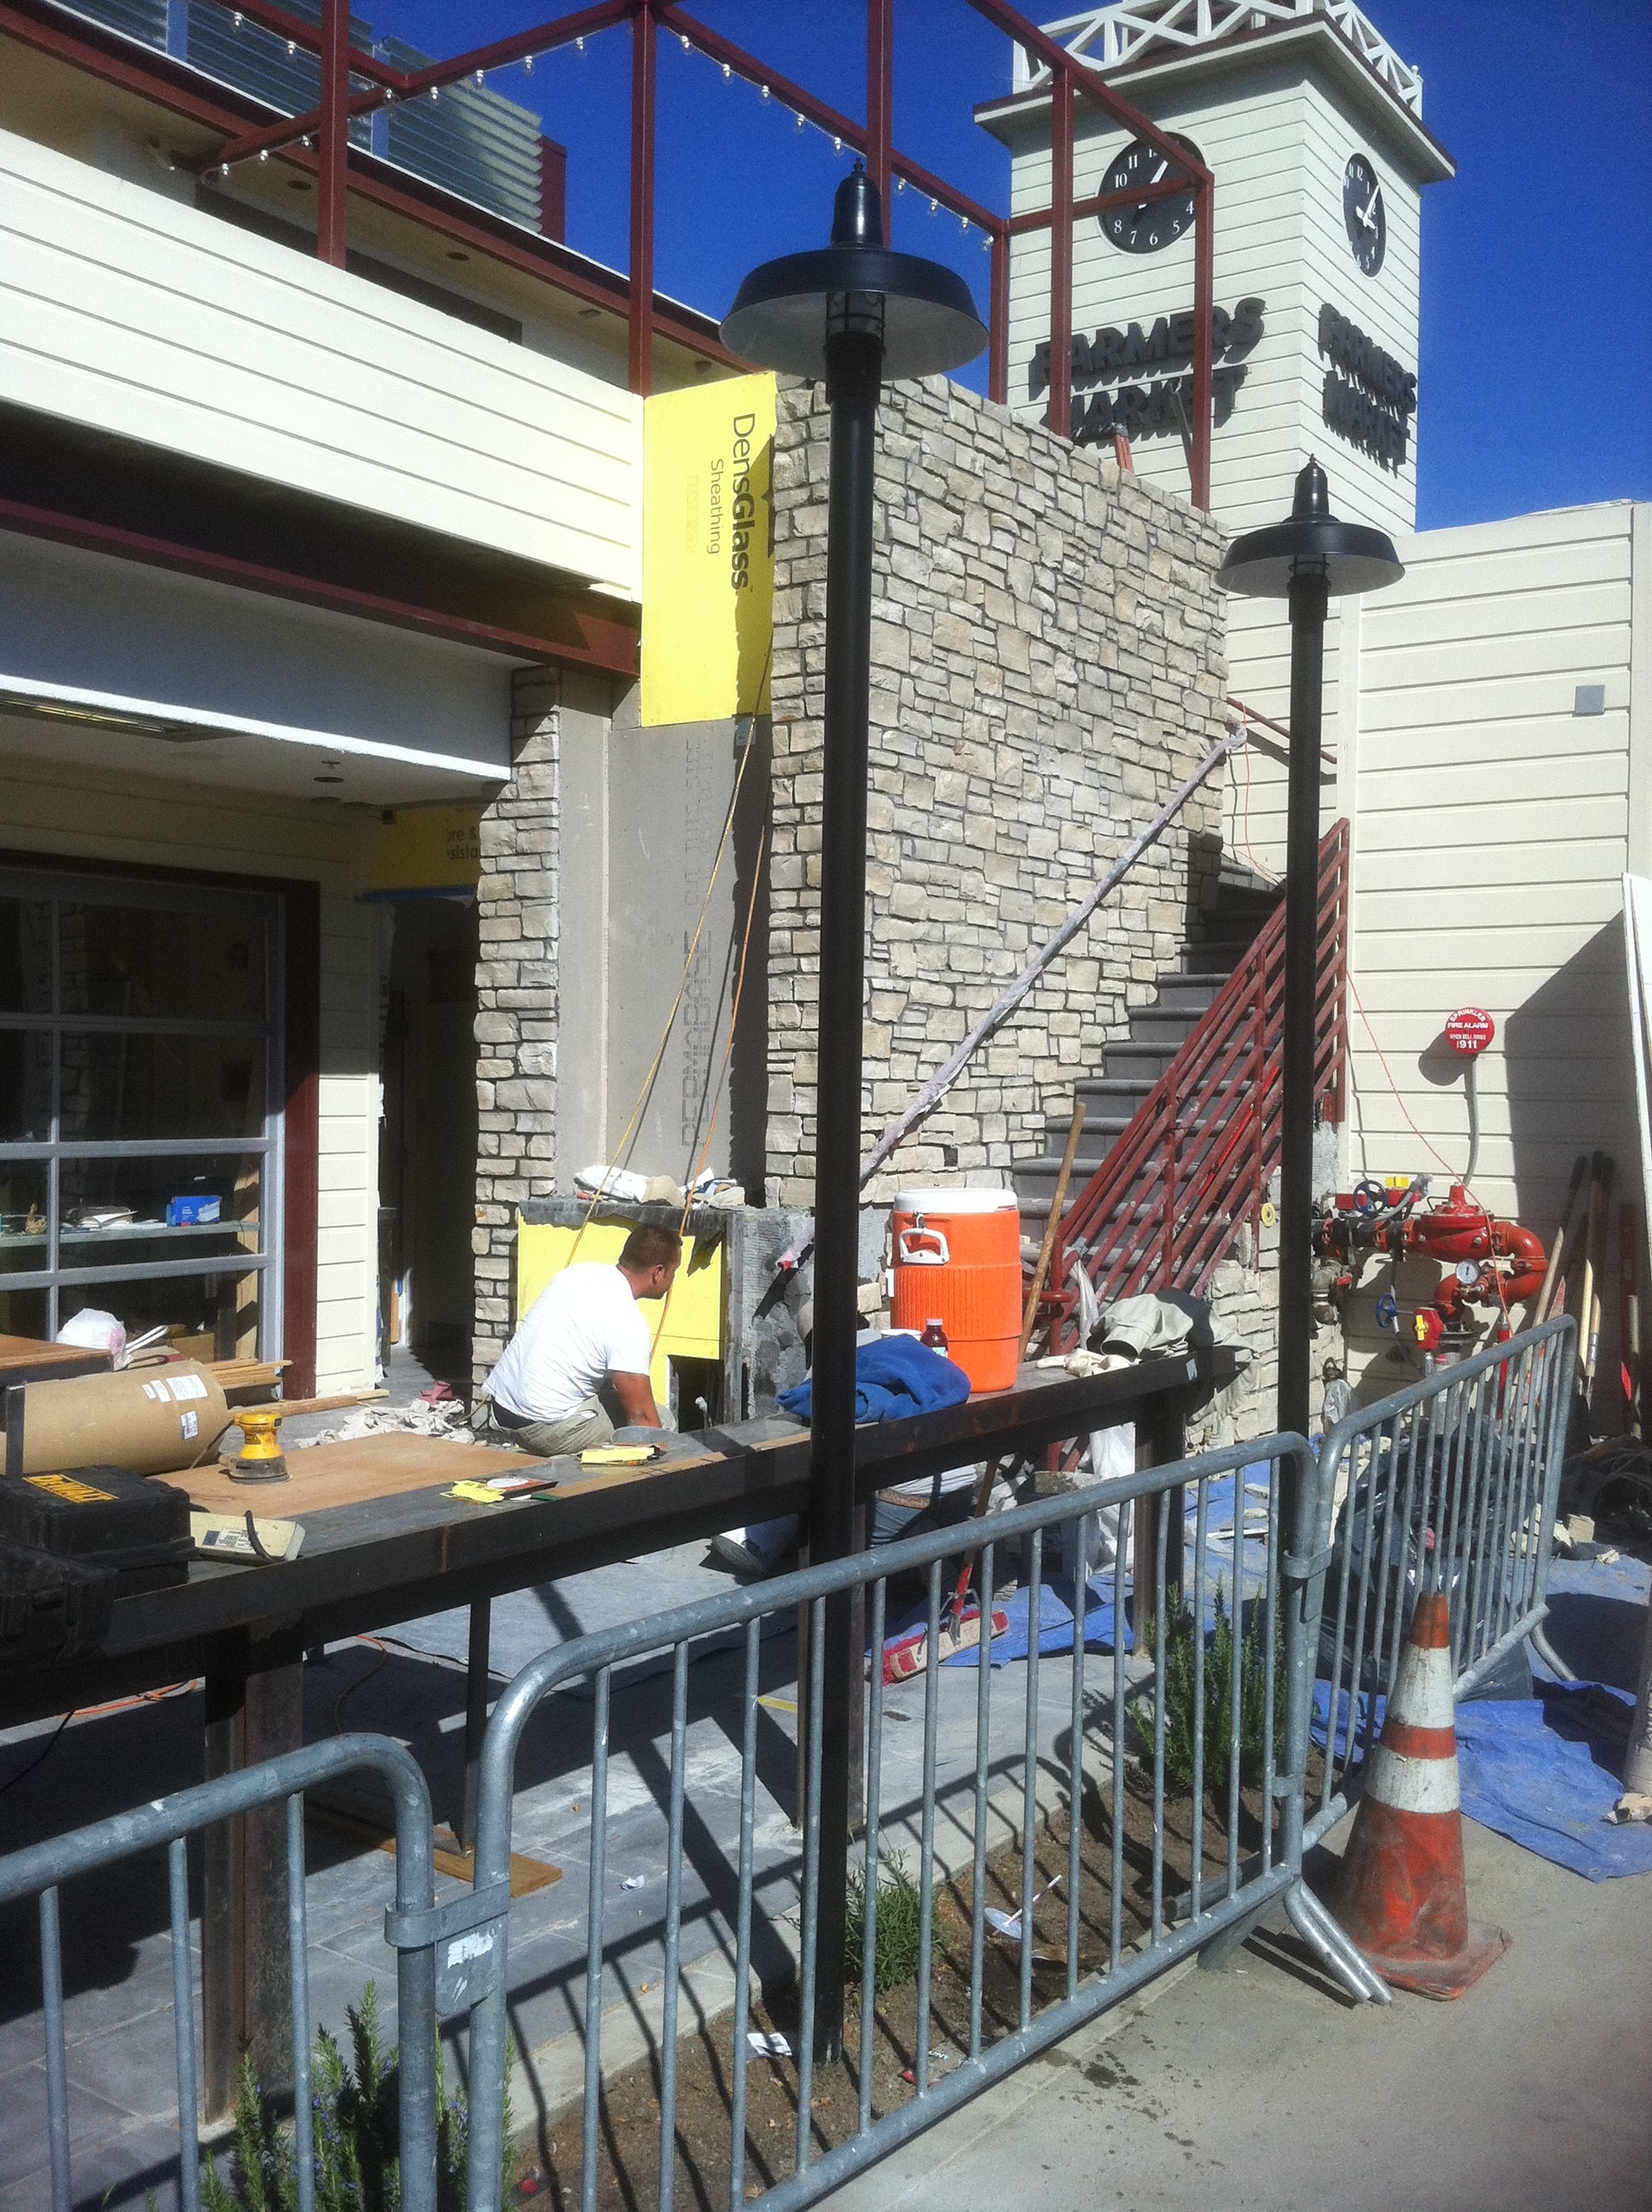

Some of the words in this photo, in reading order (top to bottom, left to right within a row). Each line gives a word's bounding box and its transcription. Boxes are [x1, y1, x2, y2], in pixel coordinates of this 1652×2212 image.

[1128, 154, 1137, 169] 11
[1114, 172, 1127, 189] 10
[1185, 201, 1195, 214] 4
[1114, 219, 1122, 234] 8
[1172, 219, 1180, 235] 5
[1130, 230, 1137, 245] 7
[1149, 232, 1158, 245] 6
[707, 458, 724, 555] Sheathing
